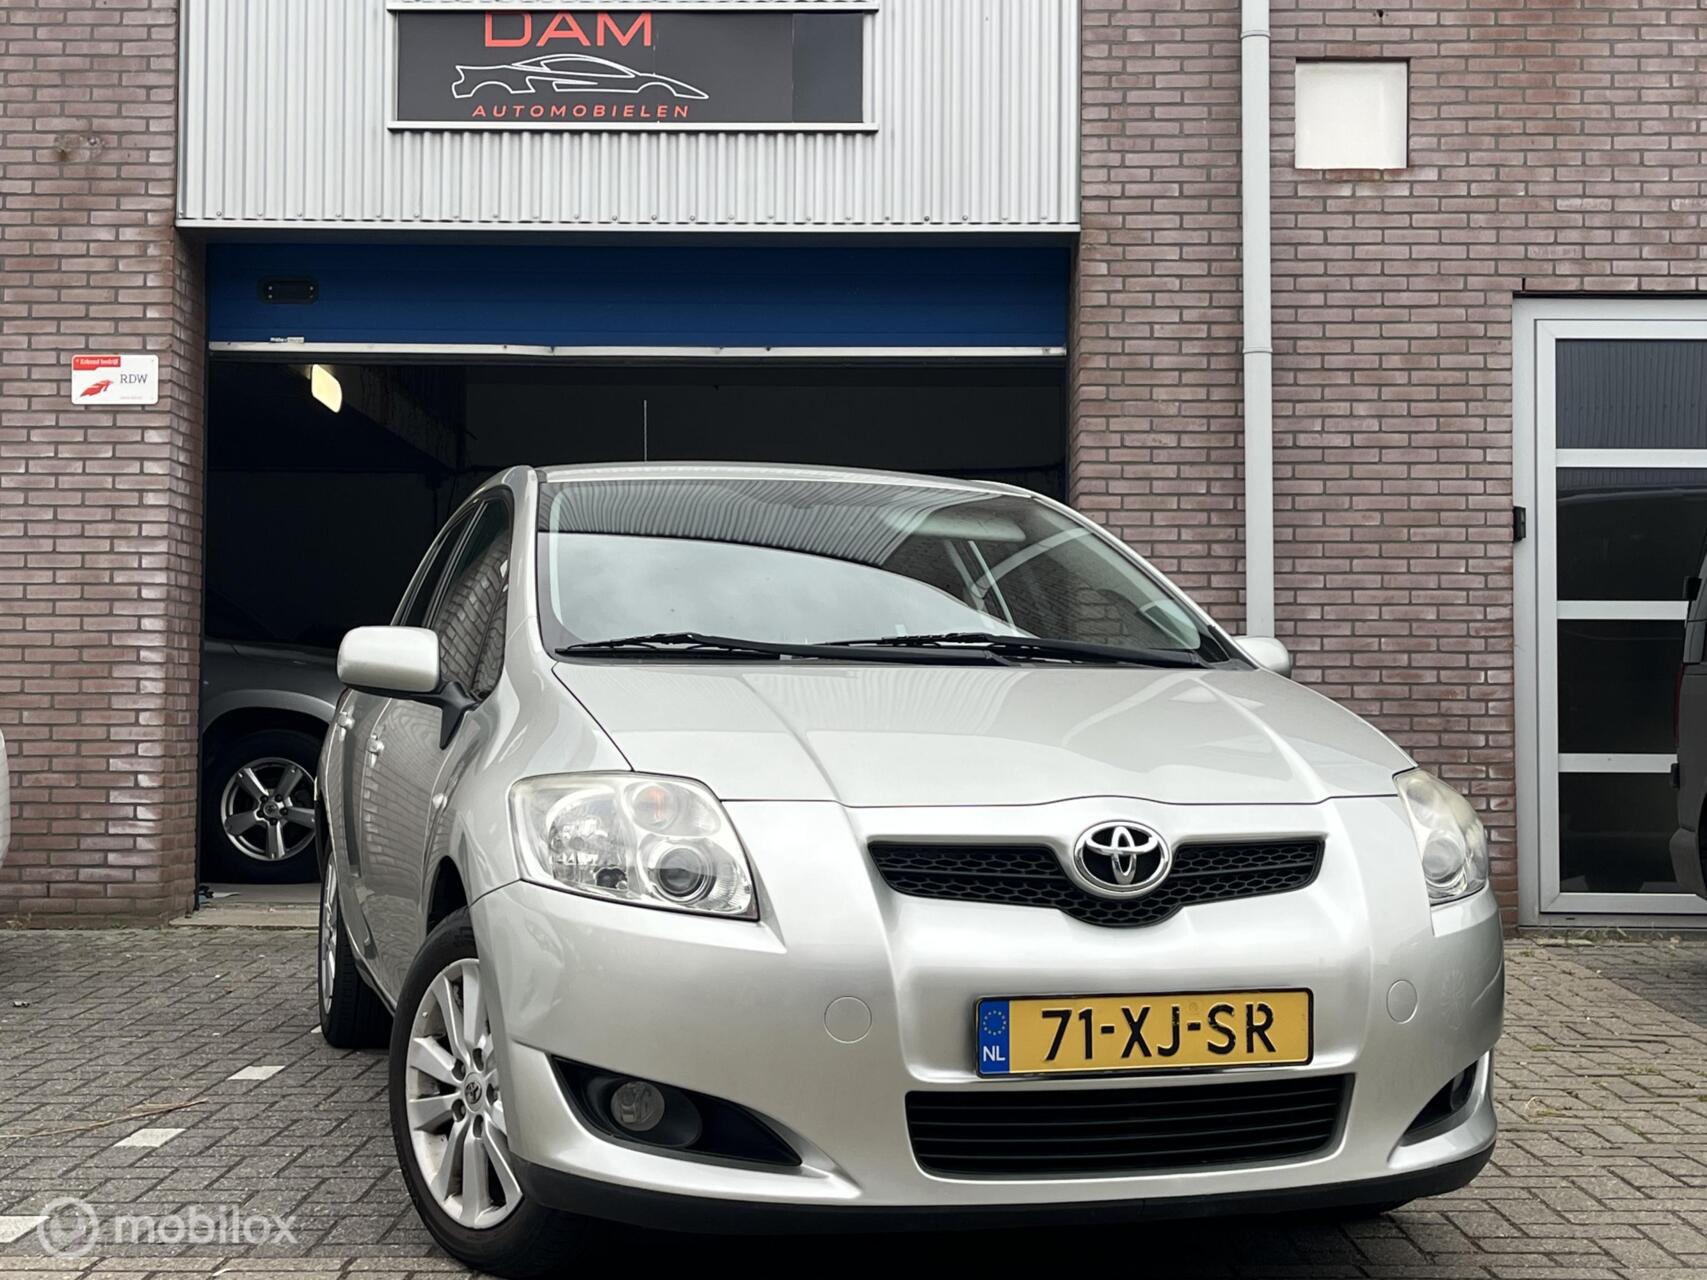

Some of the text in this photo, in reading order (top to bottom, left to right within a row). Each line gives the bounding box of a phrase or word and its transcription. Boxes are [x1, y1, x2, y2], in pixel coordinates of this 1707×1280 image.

[484, 10, 652, 48] DAM
[471, 104, 690, 118] AUTOMOBIELEN
[120, 373, 148, 384] RDW
[1041, 1002, 1277, 1062] 71-XJ-SR
[982, 1045, 1006, 1062] NL
